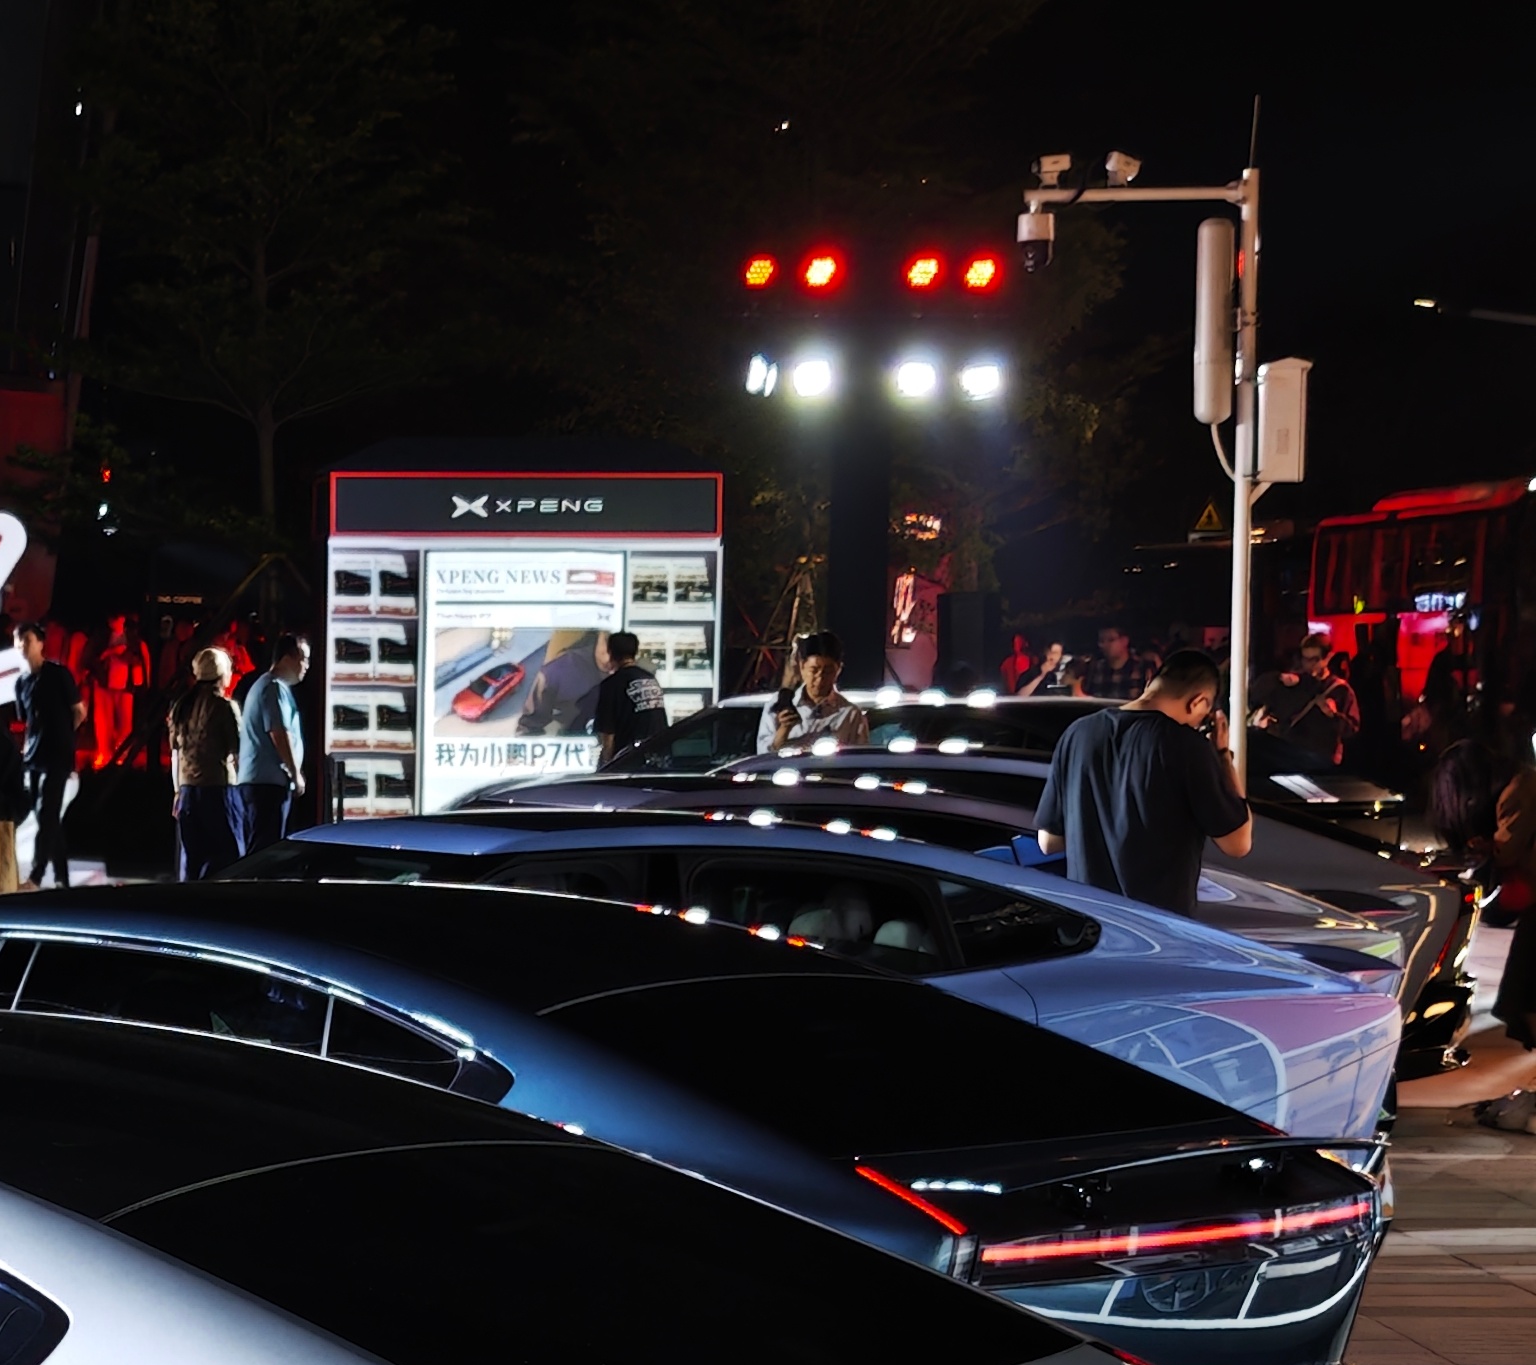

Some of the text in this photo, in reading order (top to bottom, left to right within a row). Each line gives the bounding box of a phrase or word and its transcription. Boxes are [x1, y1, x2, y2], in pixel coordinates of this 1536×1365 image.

[495, 498, 604, 513] XPENG
[436, 569, 561, 584] XPENG NEWS
